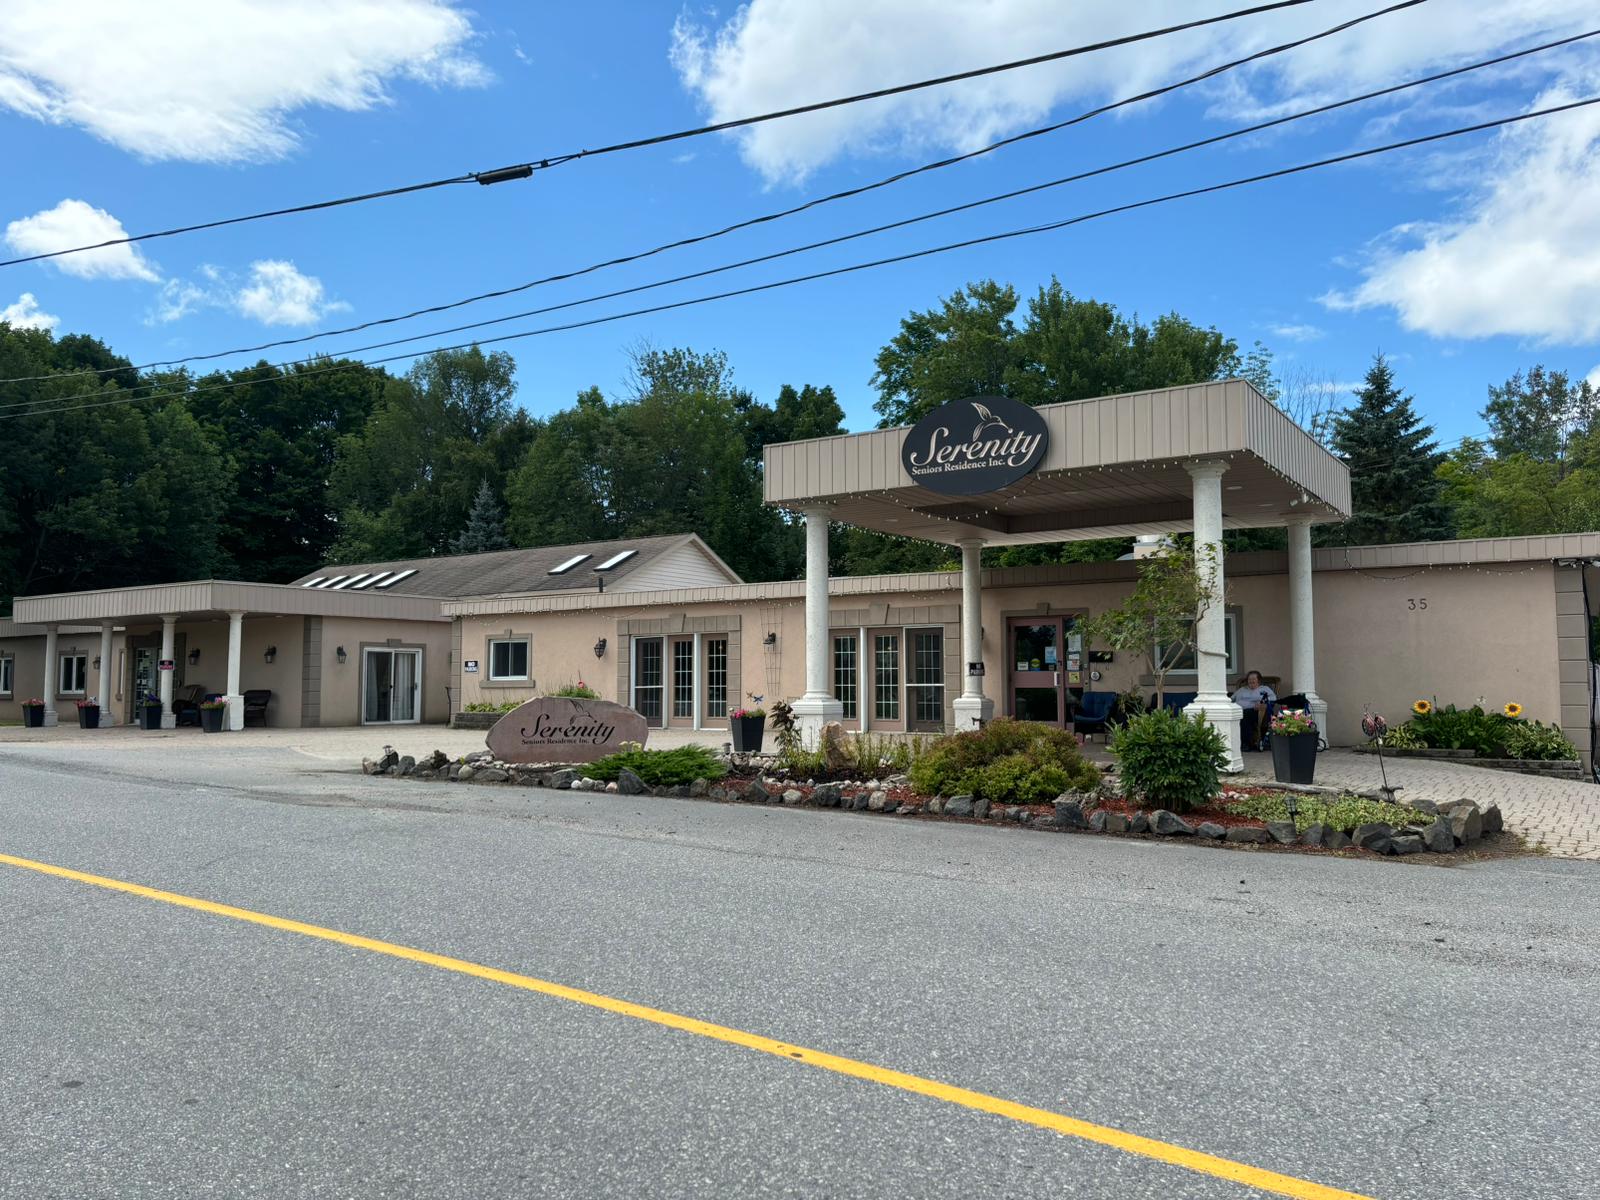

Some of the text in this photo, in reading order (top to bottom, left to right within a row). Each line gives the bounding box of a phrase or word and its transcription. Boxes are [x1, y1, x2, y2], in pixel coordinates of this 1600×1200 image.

[910, 427, 1042, 467] Serenity
[912, 457, 1006, 476] Seniors Residence Inc.
[1407, 598, 1428, 611] 35
[520, 713, 615, 745] Serenity
